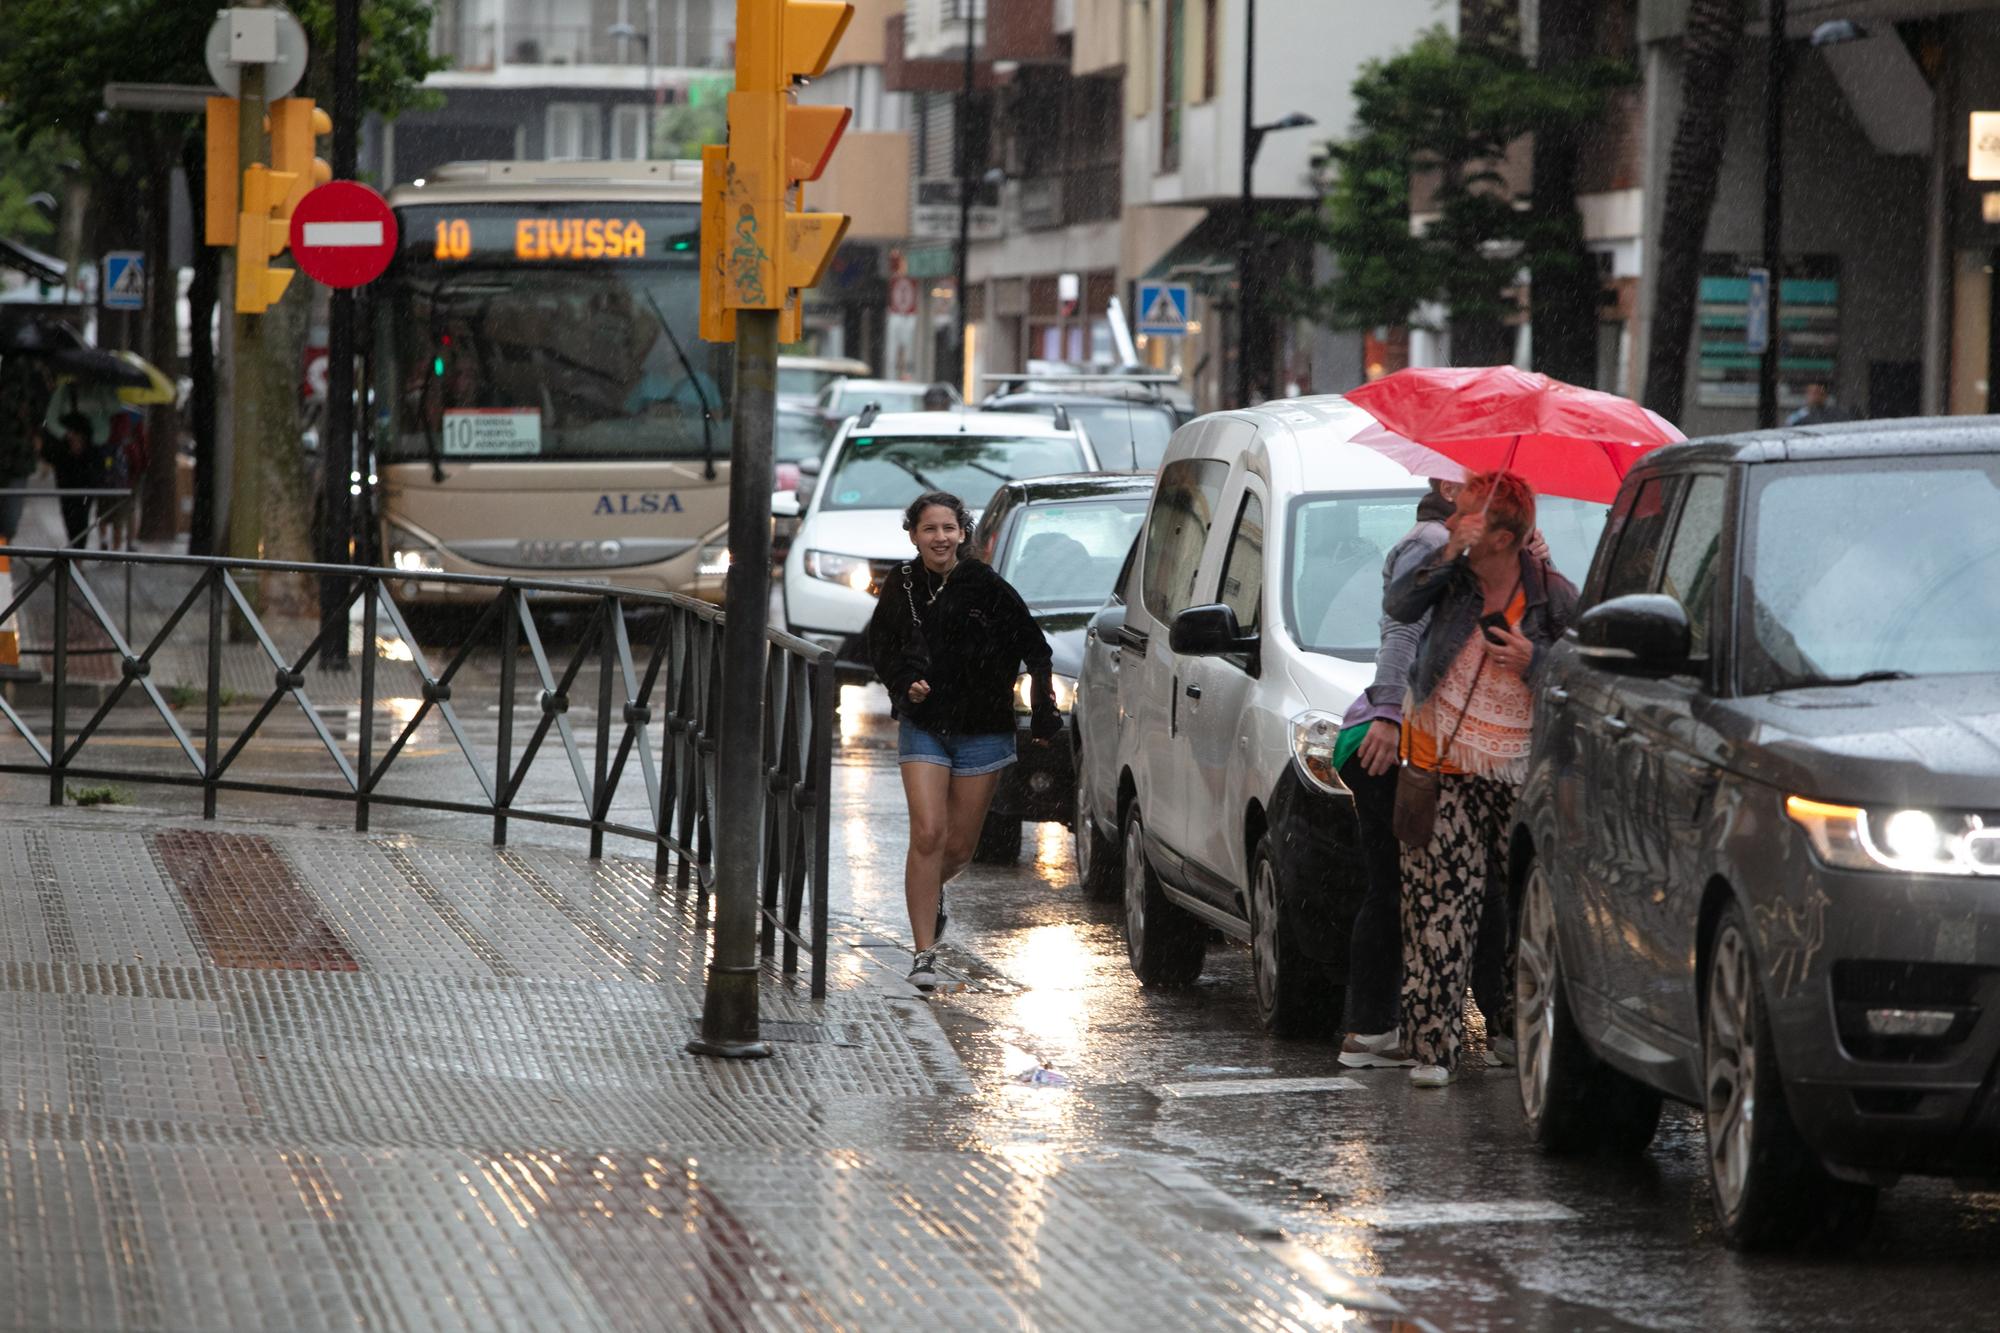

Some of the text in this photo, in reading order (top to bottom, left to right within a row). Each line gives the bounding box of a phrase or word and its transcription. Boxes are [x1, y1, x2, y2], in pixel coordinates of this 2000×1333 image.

[435, 218, 646, 259] 10 EIVISSA
[446, 418, 472, 448] 10
[593, 493, 684, 515] ALSA
